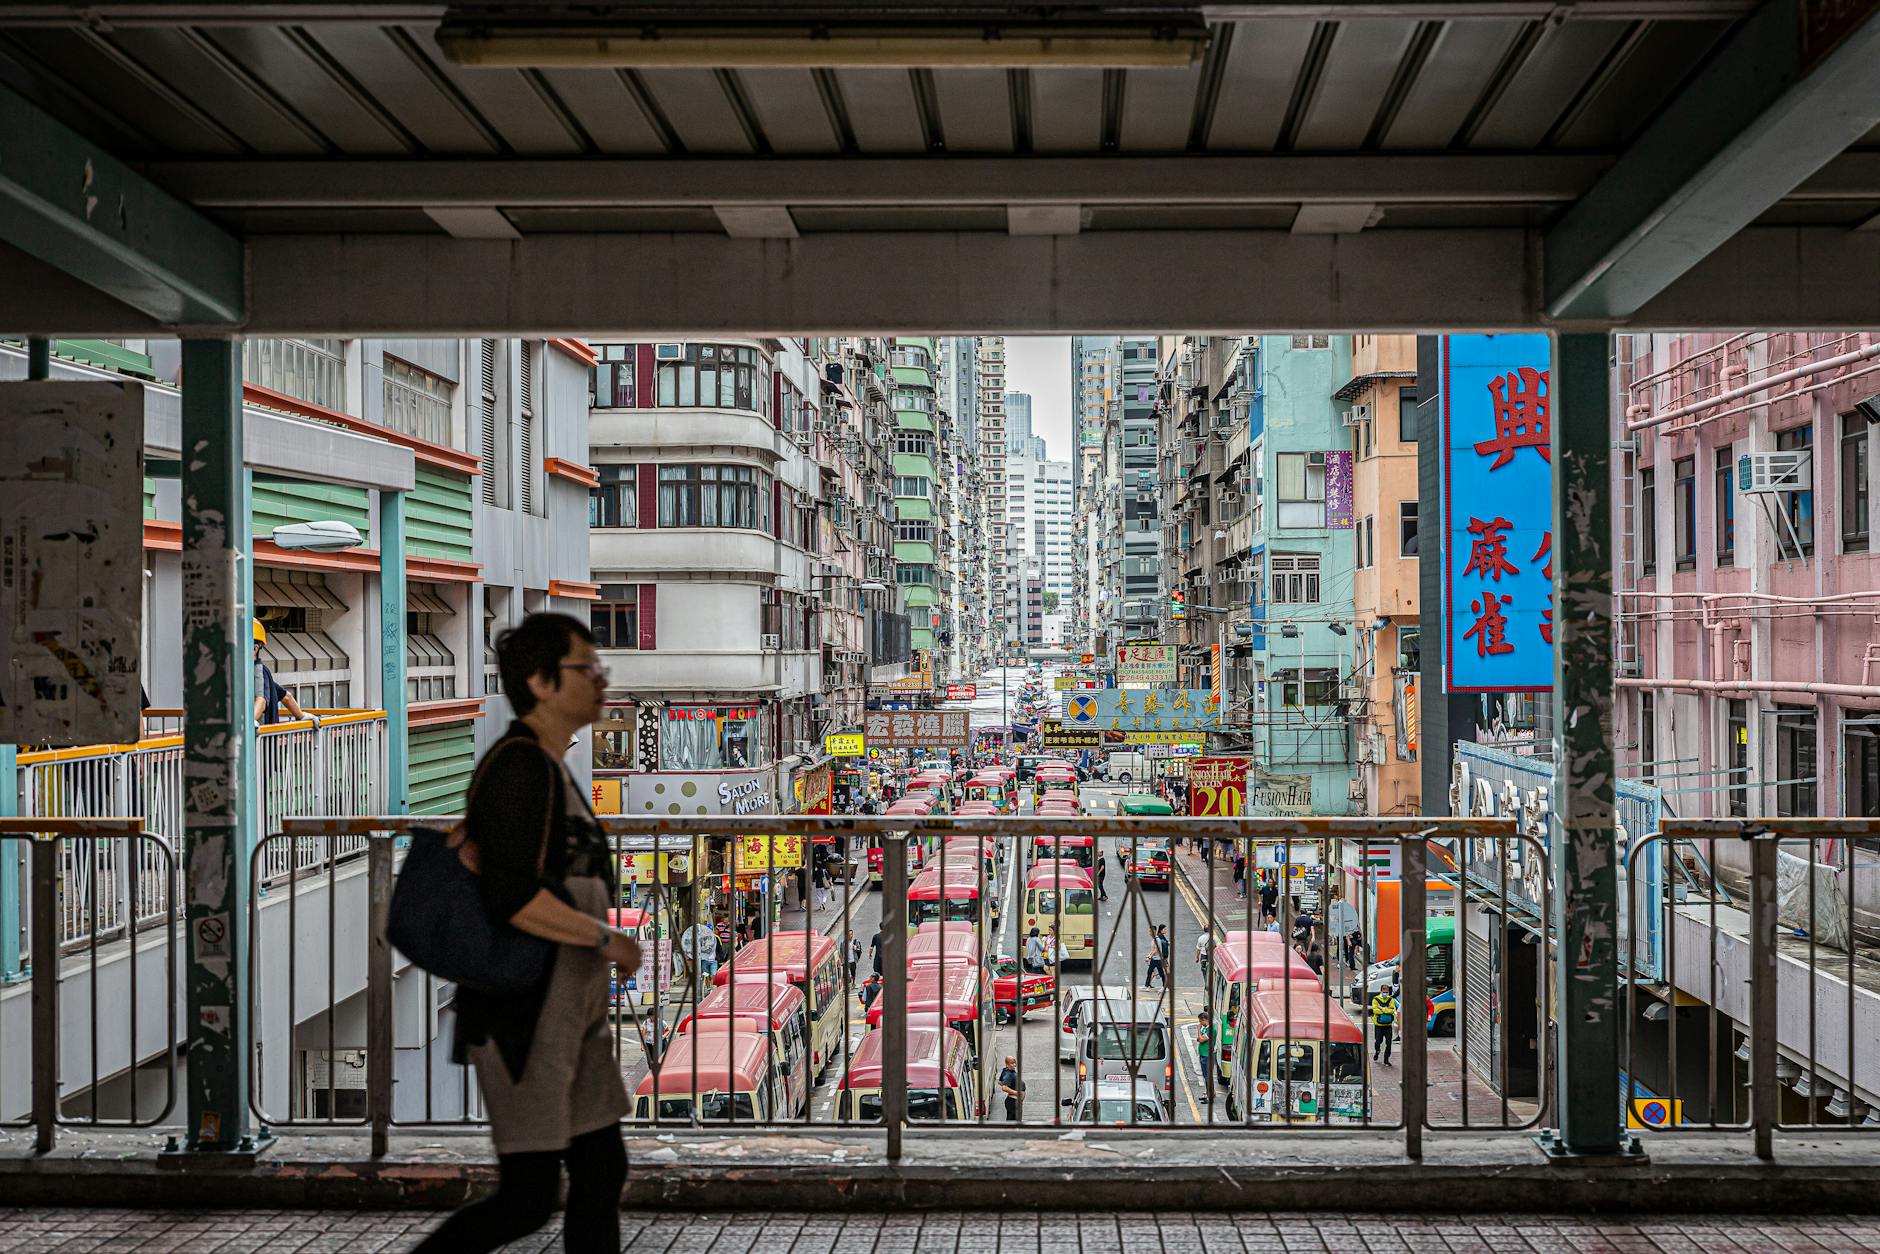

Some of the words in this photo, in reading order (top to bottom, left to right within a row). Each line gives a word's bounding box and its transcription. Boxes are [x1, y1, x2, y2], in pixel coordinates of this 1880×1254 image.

[668, 708, 716, 721] SALON
[718, 778, 761, 805] SALON
[735, 792, 770, 815] MORE
[1196, 786, 1241, 816] 20
